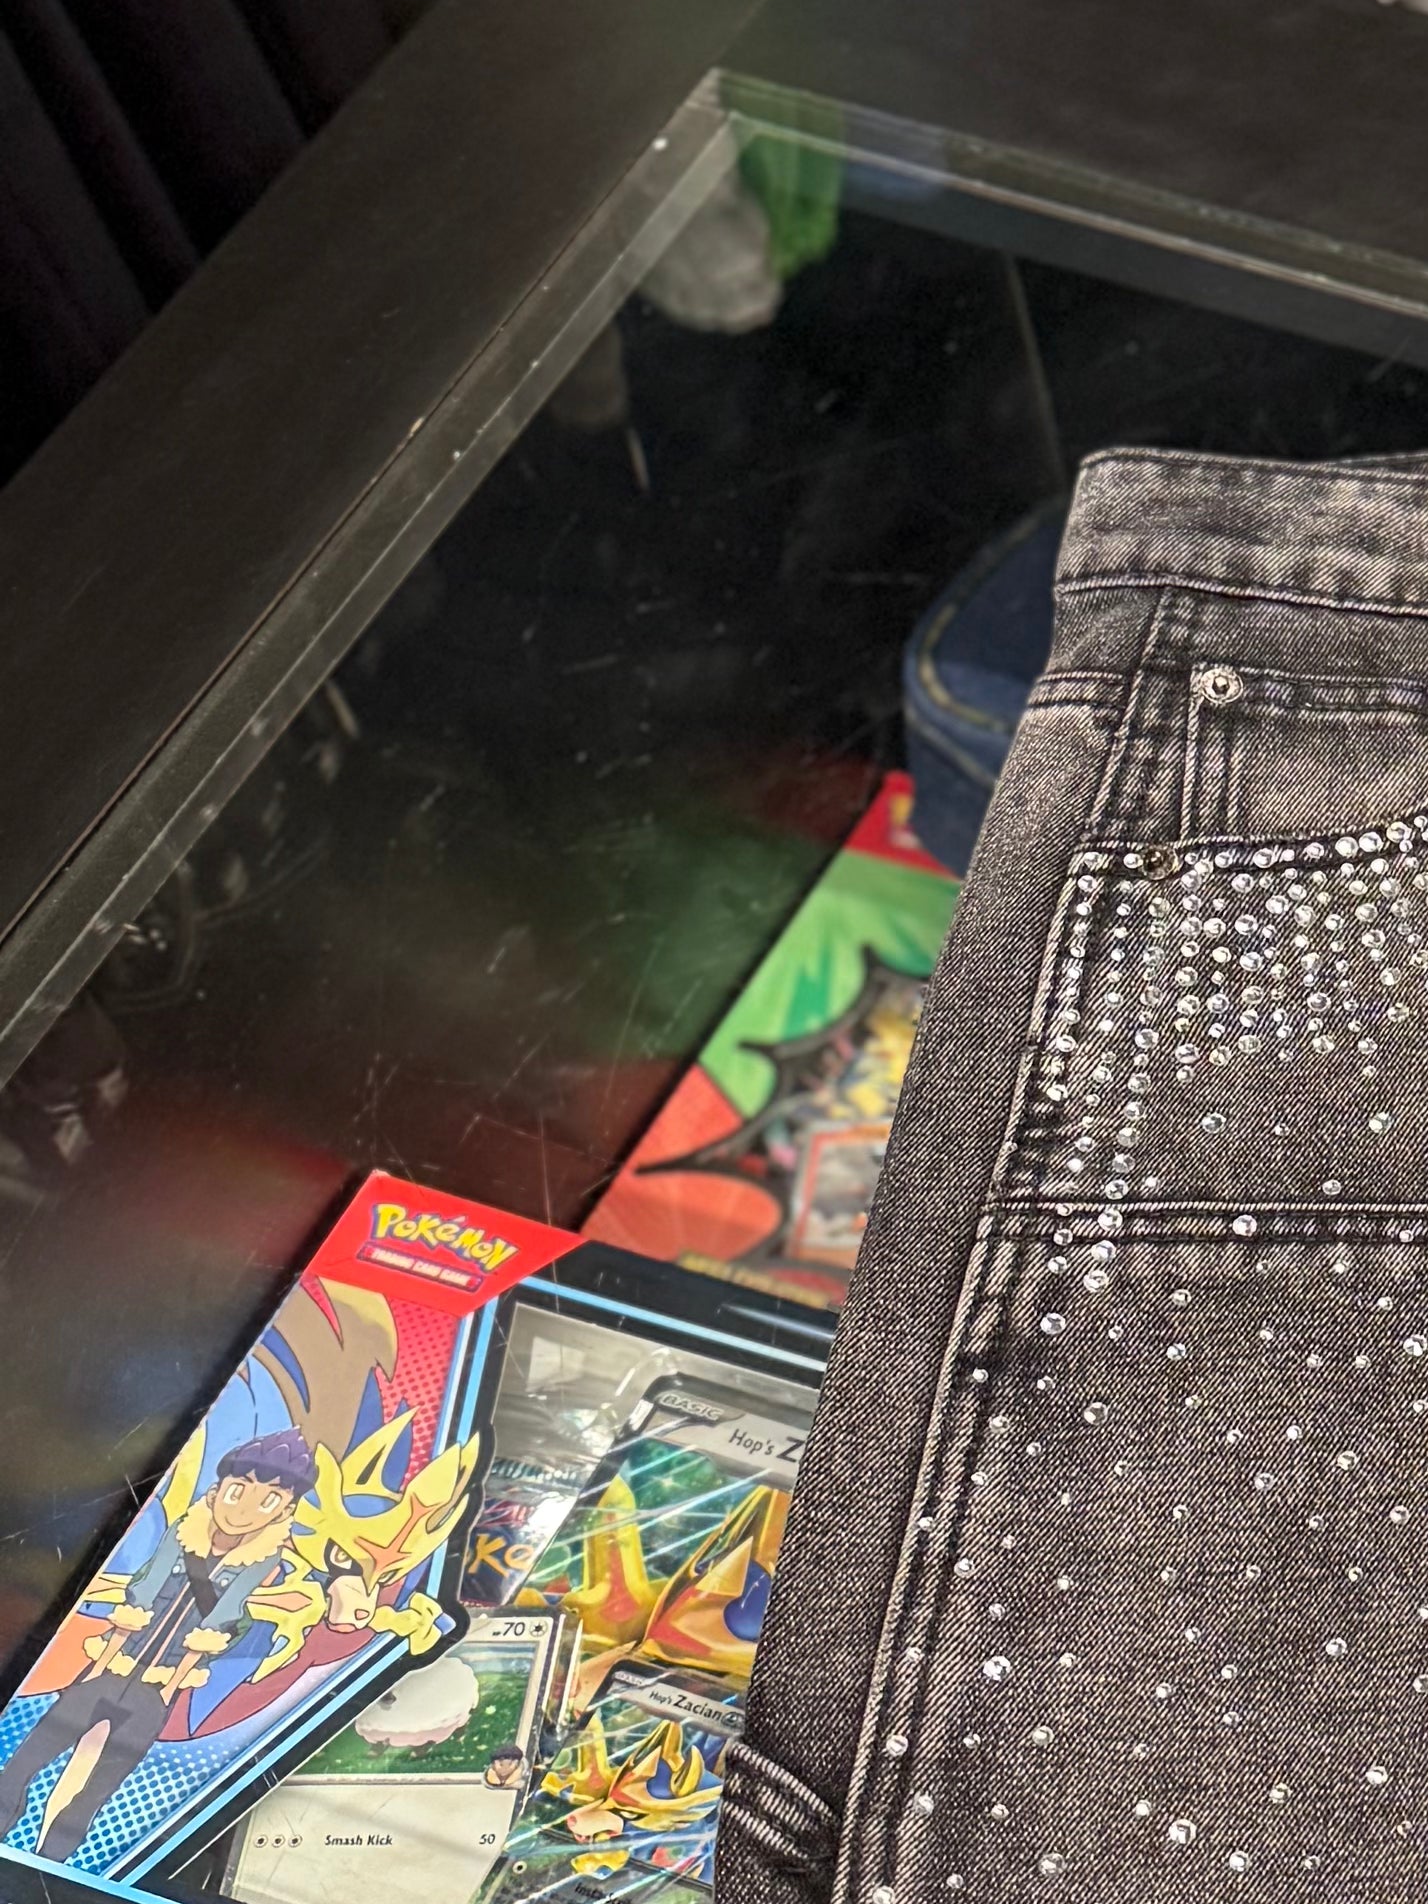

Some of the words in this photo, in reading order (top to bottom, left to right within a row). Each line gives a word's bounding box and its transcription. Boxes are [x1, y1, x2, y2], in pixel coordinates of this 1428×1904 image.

[728, 1428, 774, 1455] Hop's
[502, 1622, 526, 1637] 70
[673, 1694, 723, 1722] Zacian
[325, 1834, 363, 1846] Smash
[367, 1834, 393, 1846] Kick
[478, 1833, 496, 1846] 50
